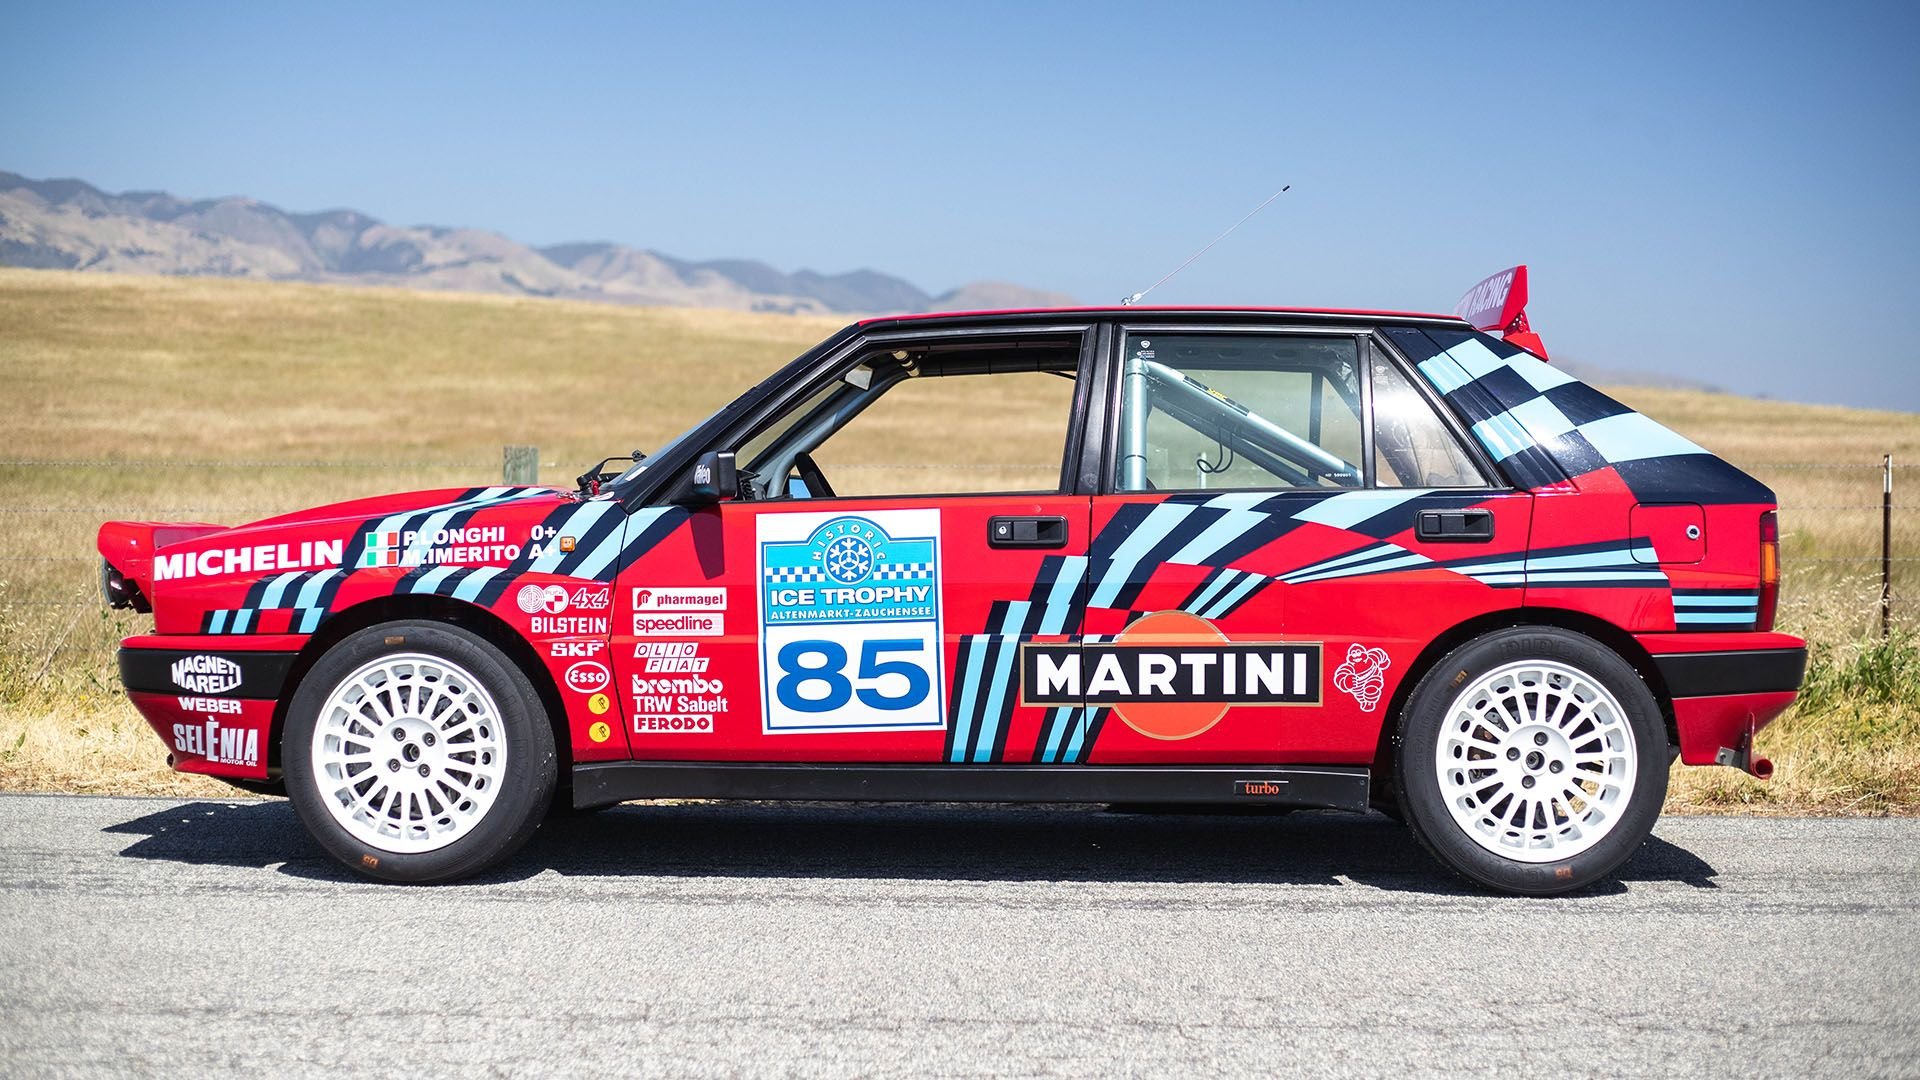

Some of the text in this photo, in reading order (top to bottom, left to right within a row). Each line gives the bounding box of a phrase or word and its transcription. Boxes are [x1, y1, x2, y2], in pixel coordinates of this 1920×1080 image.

[403, 527, 505, 546] P.LONGHI
[812, 524, 886, 561] HISTORIC
[154, 539, 343, 581] MICHELIN
[402, 545, 520, 564] M.IMERITO
[570, 587, 609, 609] 4x4
[657, 594, 723, 607] pharmagel
[771, 585, 931, 606] ICE TROPHY
[771, 606, 931, 620] ALTENMARKT-ZAUCHENSEE
[531, 617, 606, 633] BILSTEIN
[636, 616, 713, 633] speedline
[551, 642, 604, 657] SKF
[635, 643, 697, 657] OLIO
[172, 655, 242, 681] MAGNETI
[648, 659, 707, 671] FIAT
[569, 669, 606, 684] Esso
[777, 638, 930, 713] 85
[1036, 653, 1307, 696] MARTINI
[632, 674, 723, 694] brembo
[178, 697, 242, 714] WEBER
[633, 696, 728, 713] TRW Sabelt
[637, 717, 710, 730] FERODO
[220, 758, 258, 767] MOTOR OIL
[1245, 781, 1279, 794] turbo
